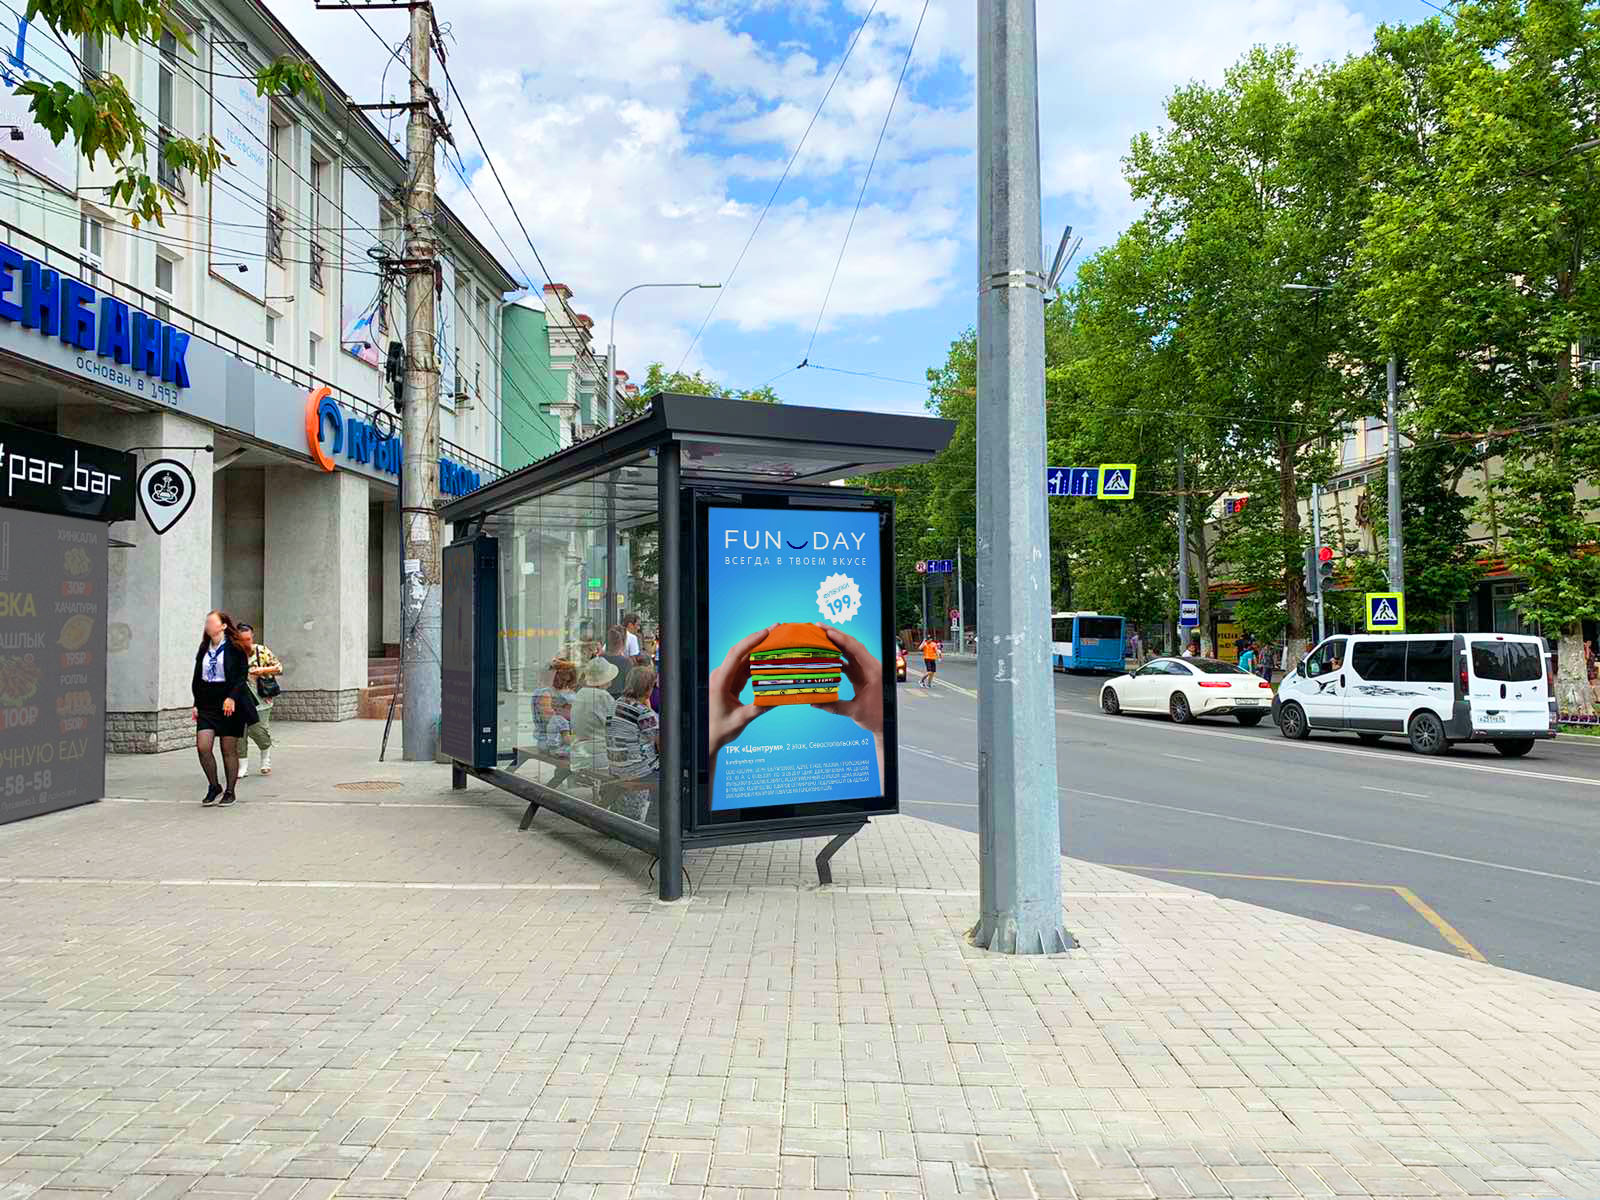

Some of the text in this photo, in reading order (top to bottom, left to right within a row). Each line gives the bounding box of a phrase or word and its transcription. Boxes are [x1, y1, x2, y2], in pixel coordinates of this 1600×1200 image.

[151, 382, 178, 405] 1993
[57, 528, 98, 545] ХИНКАЛИ
[725, 529, 866, 550] FUN DAY
[724, 557, 867, 566] ВСЕГДА В ТВОЕМ ВКУСЕ
[54, 601, 97, 614] ХАЧАПУРИ
[60, 674, 87, 686] РОЛЛЫ
[59, 738, 89, 761] ЕДУ
[726, 745, 740, 754] ТРК
[862, 738, 869, 746] 62
